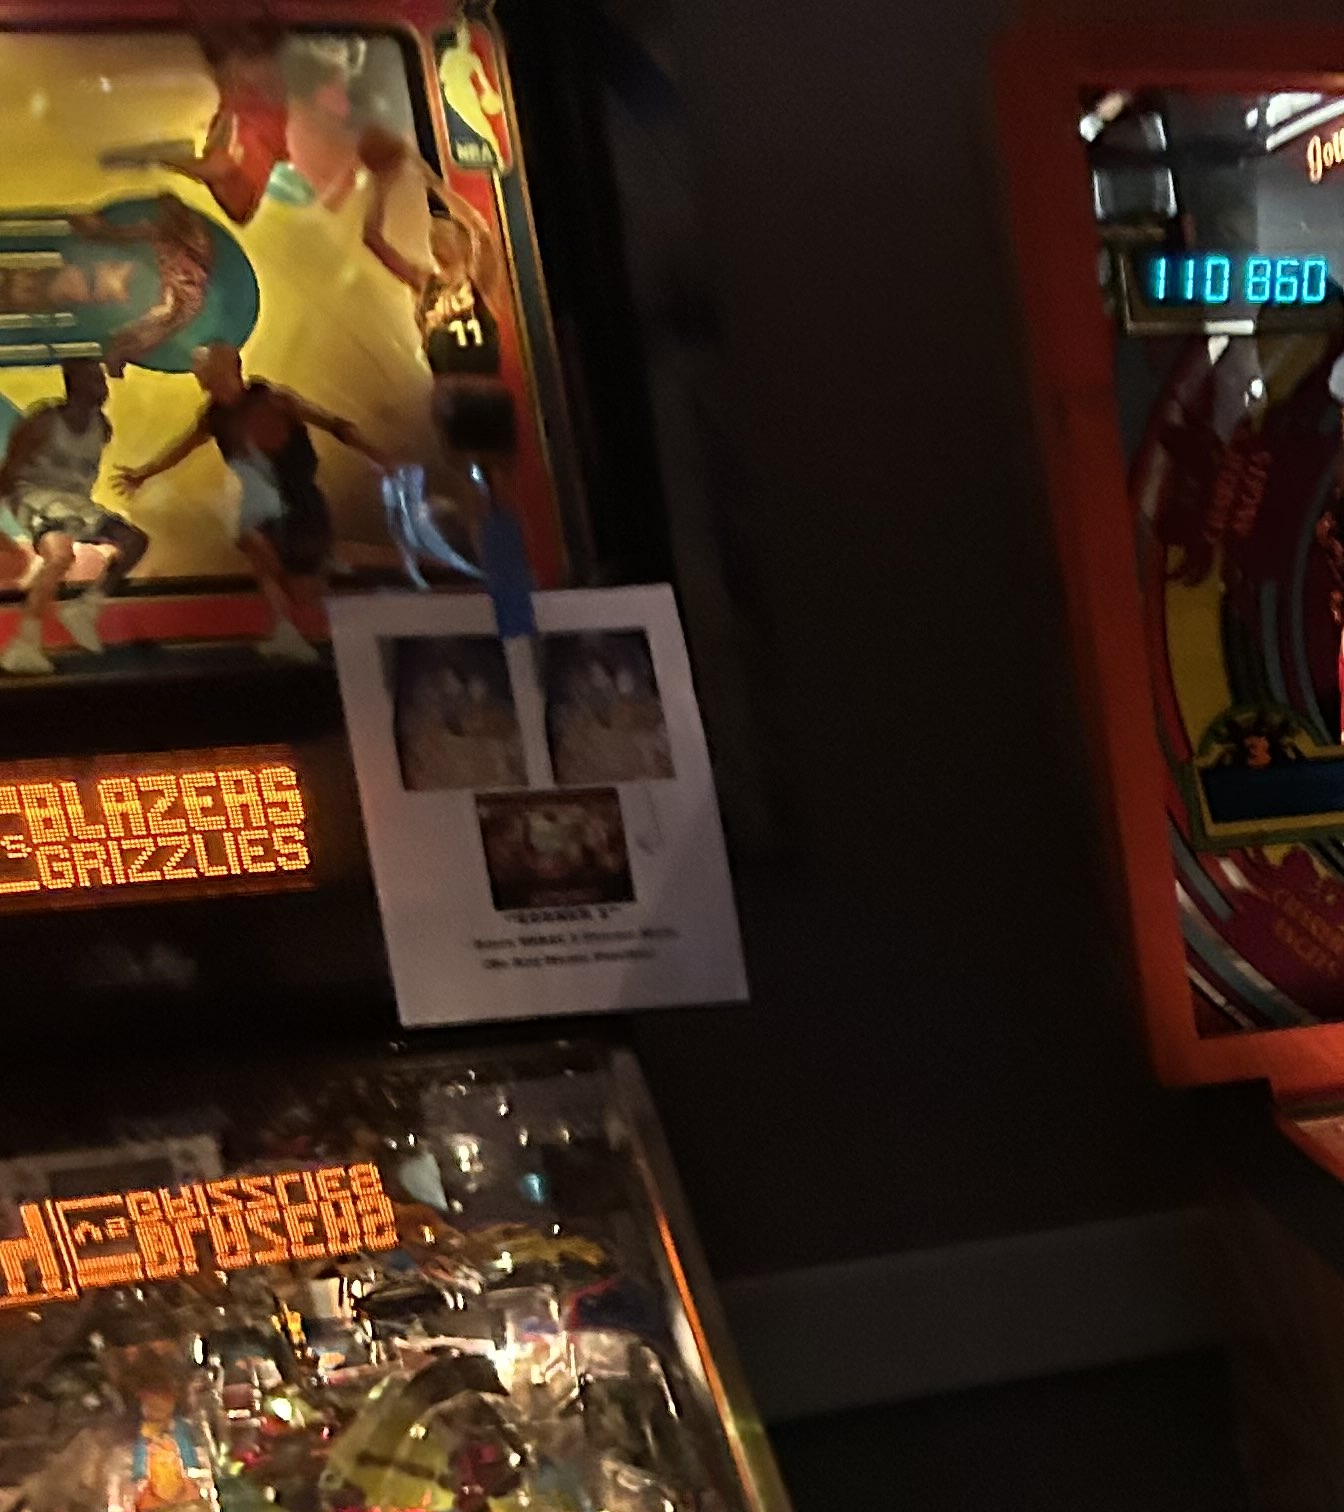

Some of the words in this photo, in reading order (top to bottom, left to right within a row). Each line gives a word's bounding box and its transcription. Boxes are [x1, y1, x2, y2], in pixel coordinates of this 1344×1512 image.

[1155, 257, 1229, 303] 110
[1247, 257, 1327, 303] 860
[448, 319, 483, 347] 11
[20, 766, 305, 844] BLAZERS
[37, 826, 311, 890] GRIZZLIES
